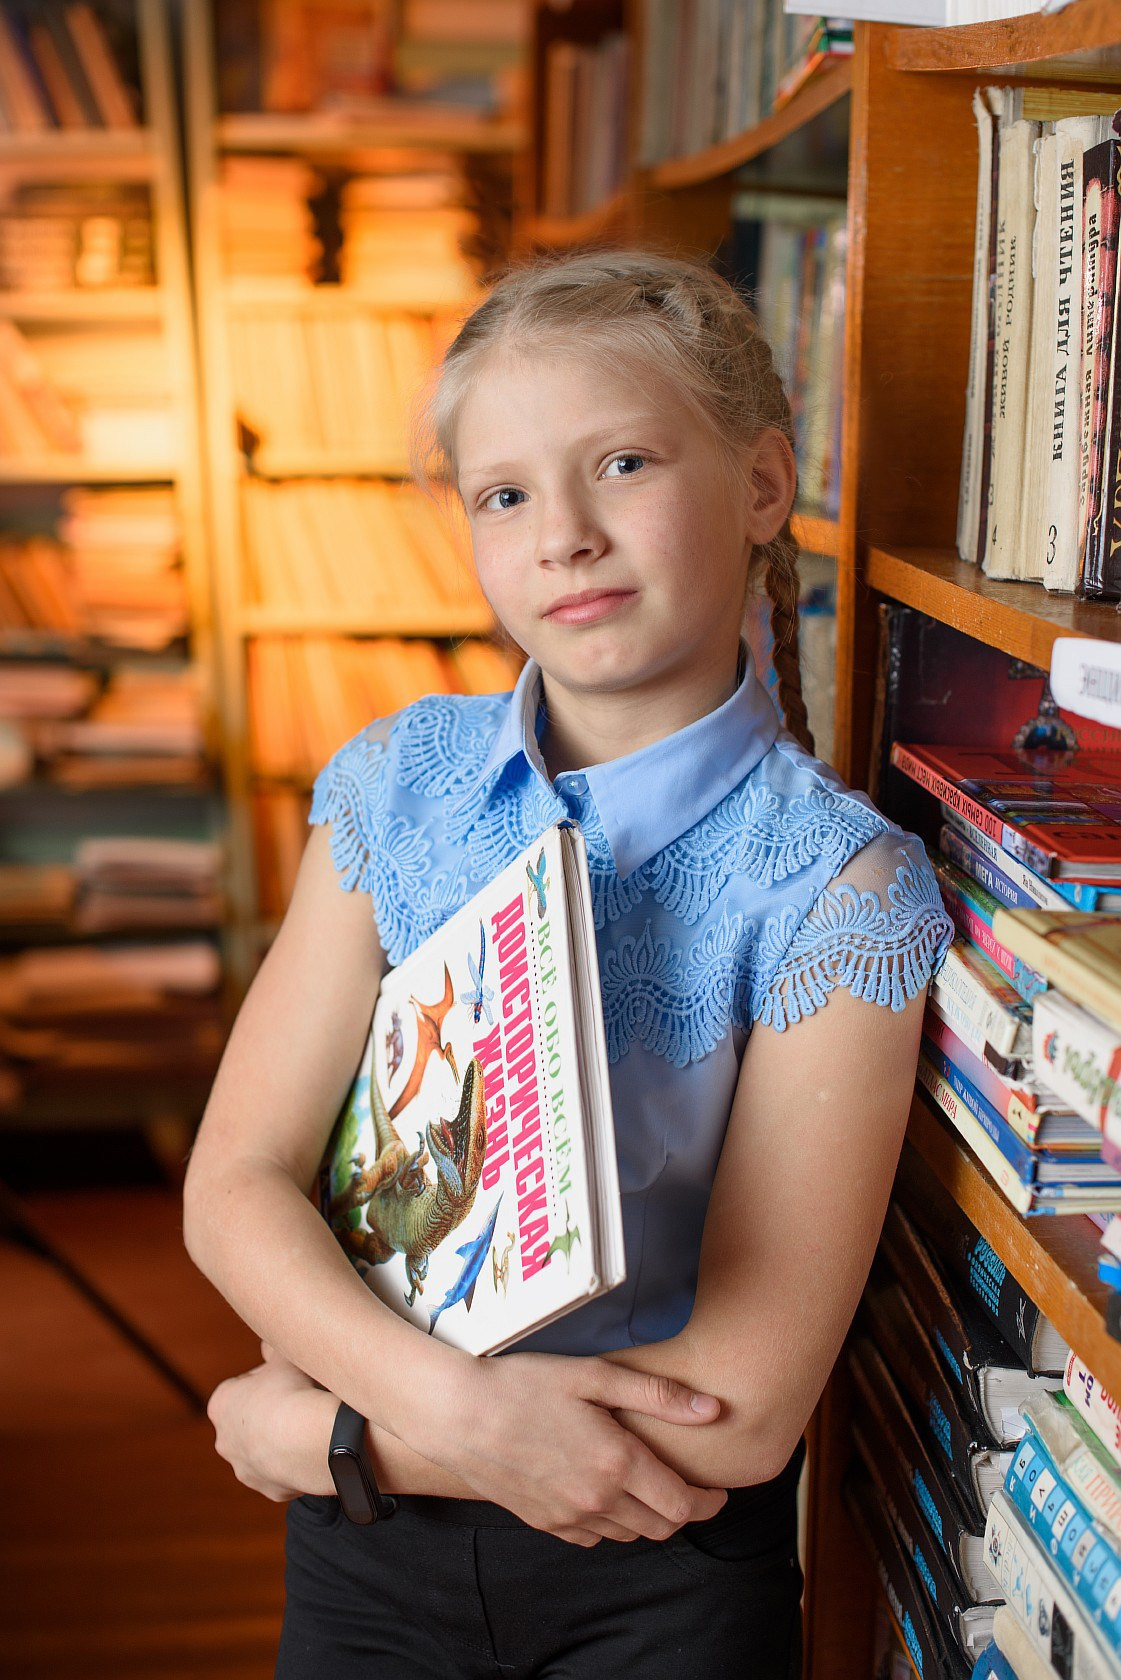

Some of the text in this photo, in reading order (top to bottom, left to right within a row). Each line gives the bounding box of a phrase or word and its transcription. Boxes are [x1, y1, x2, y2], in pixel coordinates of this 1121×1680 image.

[1000, 235, 1017, 419] ЖИВОЙ РОДНИК
[1052, 158, 1075, 462] КНИГА ДЛЯ ЧТЕНИЯ
[961, 798, 983, 827] самых
[975, 861, 993, 889] МЕГА
[985, 814, 997, 838] 100
[473, 1021, 511, 1192] ЖИЗНЬ
[491, 891, 552, 1283] ДОИСТОРИЧЕСКАЯ
[536, 920, 574, 1195] ВСЁ ОБО ВСЁМ
[940, 1088, 958, 1120] МИРА
